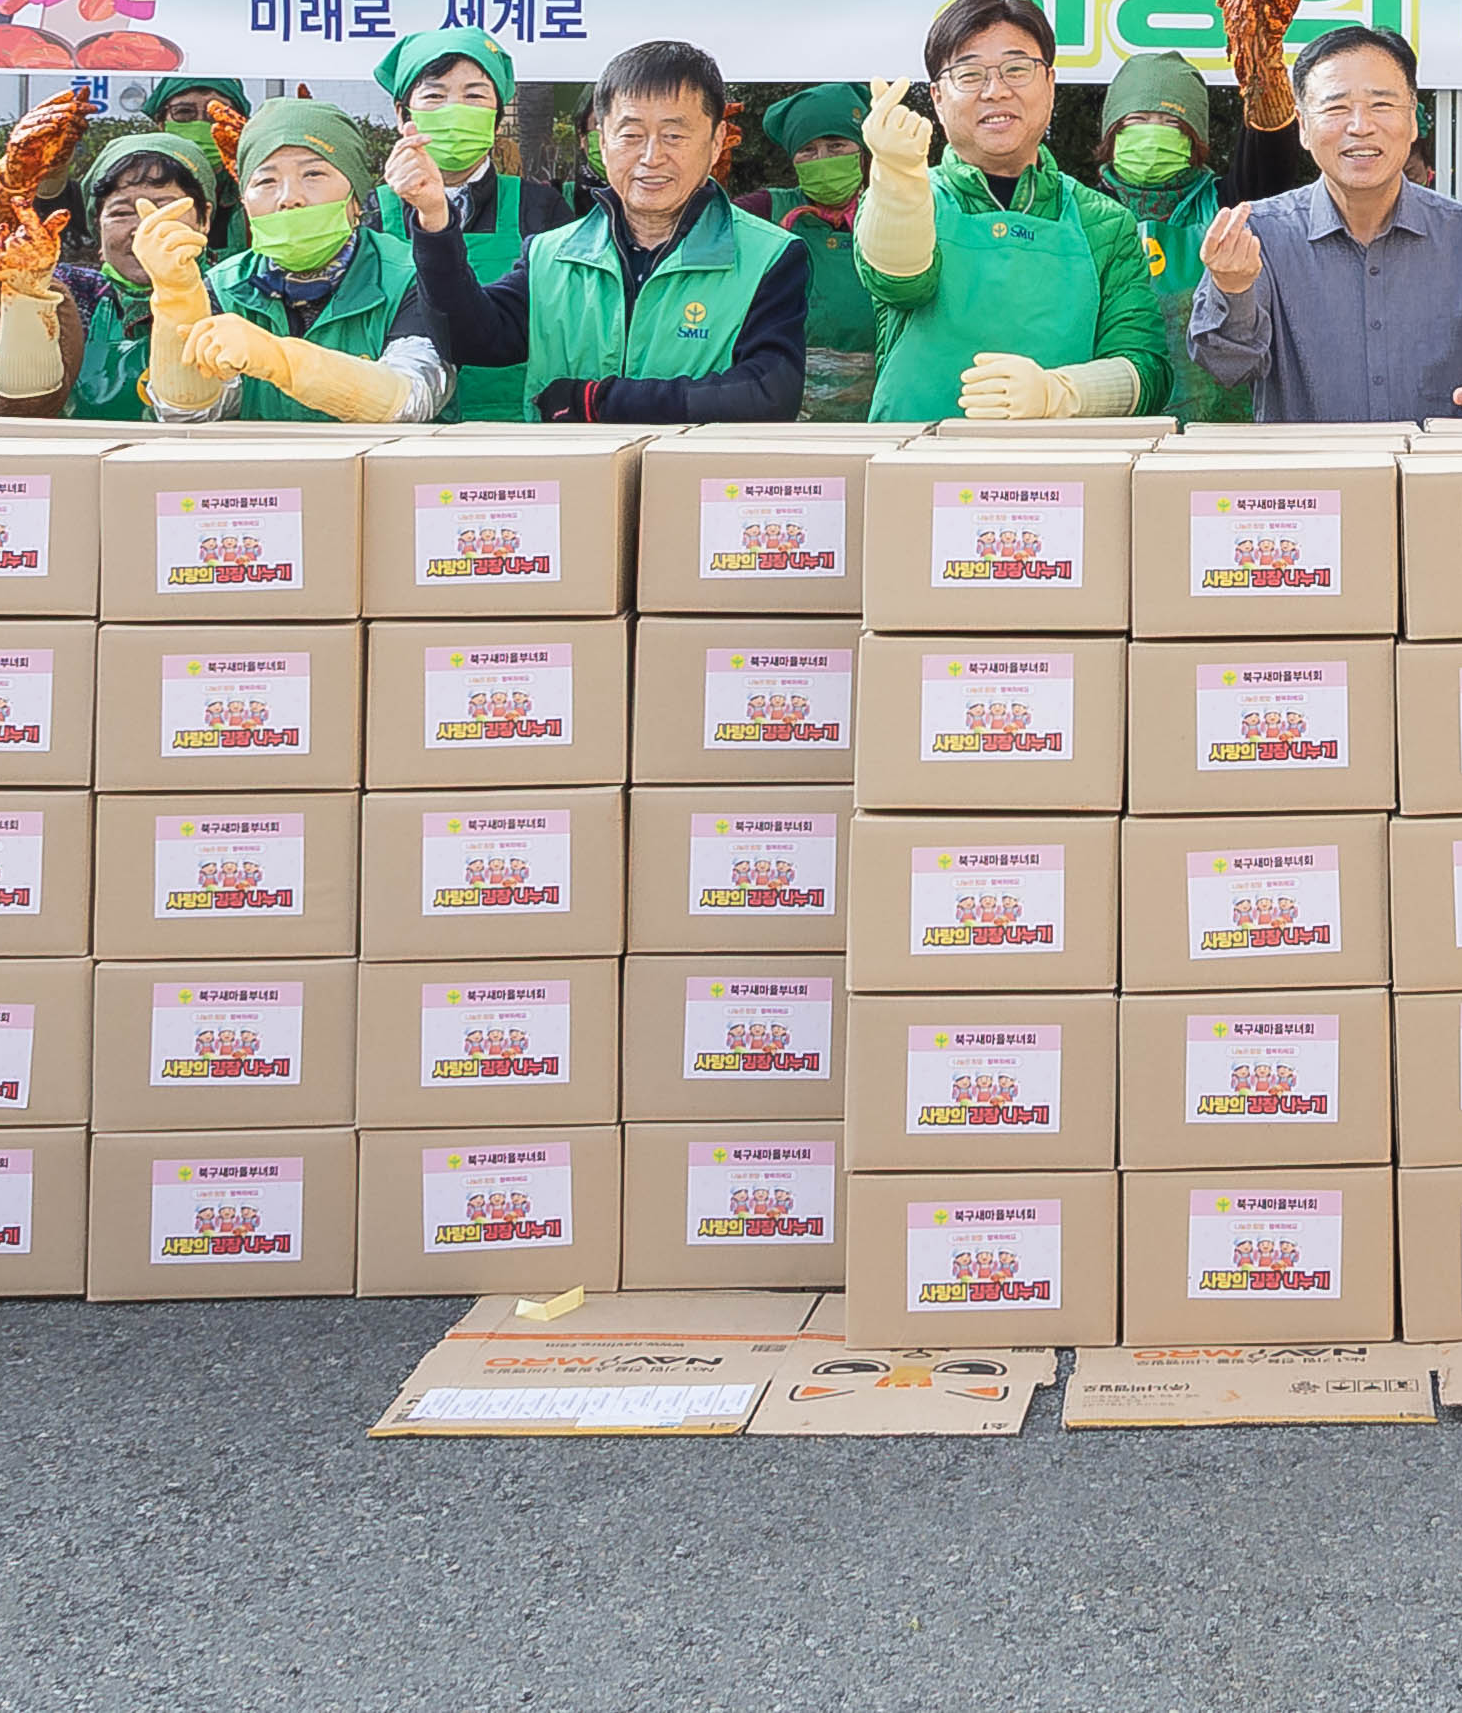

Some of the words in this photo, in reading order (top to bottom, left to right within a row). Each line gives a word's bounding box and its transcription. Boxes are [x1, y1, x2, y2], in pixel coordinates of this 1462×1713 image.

[745, 485, 822, 495] 북구새마을부녀회
[710, 551, 756, 570] 사랑의
[756, 551, 788, 570] 김장
[788, 550, 834, 569] 나누기
[207, 660, 286, 672] 북구새마을부녀회
[172, 729, 219, 748] 사랑의
[219, 728, 252, 747] 김장
[252, 727, 298, 747] 나누기
[958, 854, 1040, 865] 북구새마을부녀회
[1233, 854, 1314, 869] 북구새마을부녀회
[922, 925, 971, 946] 사랑의
[971, 925, 1004, 945] 김장
[1004, 924, 1052, 944] 나누기
[1200, 928, 1248, 950] 사랑의
[1248, 926, 1282, 948] 김장
[1282, 924, 1330, 946] 나누기
[467, 988, 546, 1000] 북구새마을부녀회
[730, 985, 808, 994] 북구새마을부녀회
[431, 1058, 479, 1078] 사랑의
[479, 1057, 511, 1077] 김장
[511, 1056, 558, 1076] 나누기
[693, 1052, 740, 1070] 사랑의
[740, 1052, 773, 1071] 김장
[772, 1052, 819, 1071] 나누기
[198, 1166, 279, 1177] 북구새마을부녀회
[1237, 1198, 1318, 1209] 북구새마을부녀회
[161, 1235, 210, 1255] 사랑의
[209, 1235, 243, 1254] 김장
[242, 1234, 290, 1253] 나누기
[1199, 1270, 1248, 1290] 사랑의
[1248, 1270, 1282, 1290] 김장
[1281, 1270, 1330, 1290] 나누기
